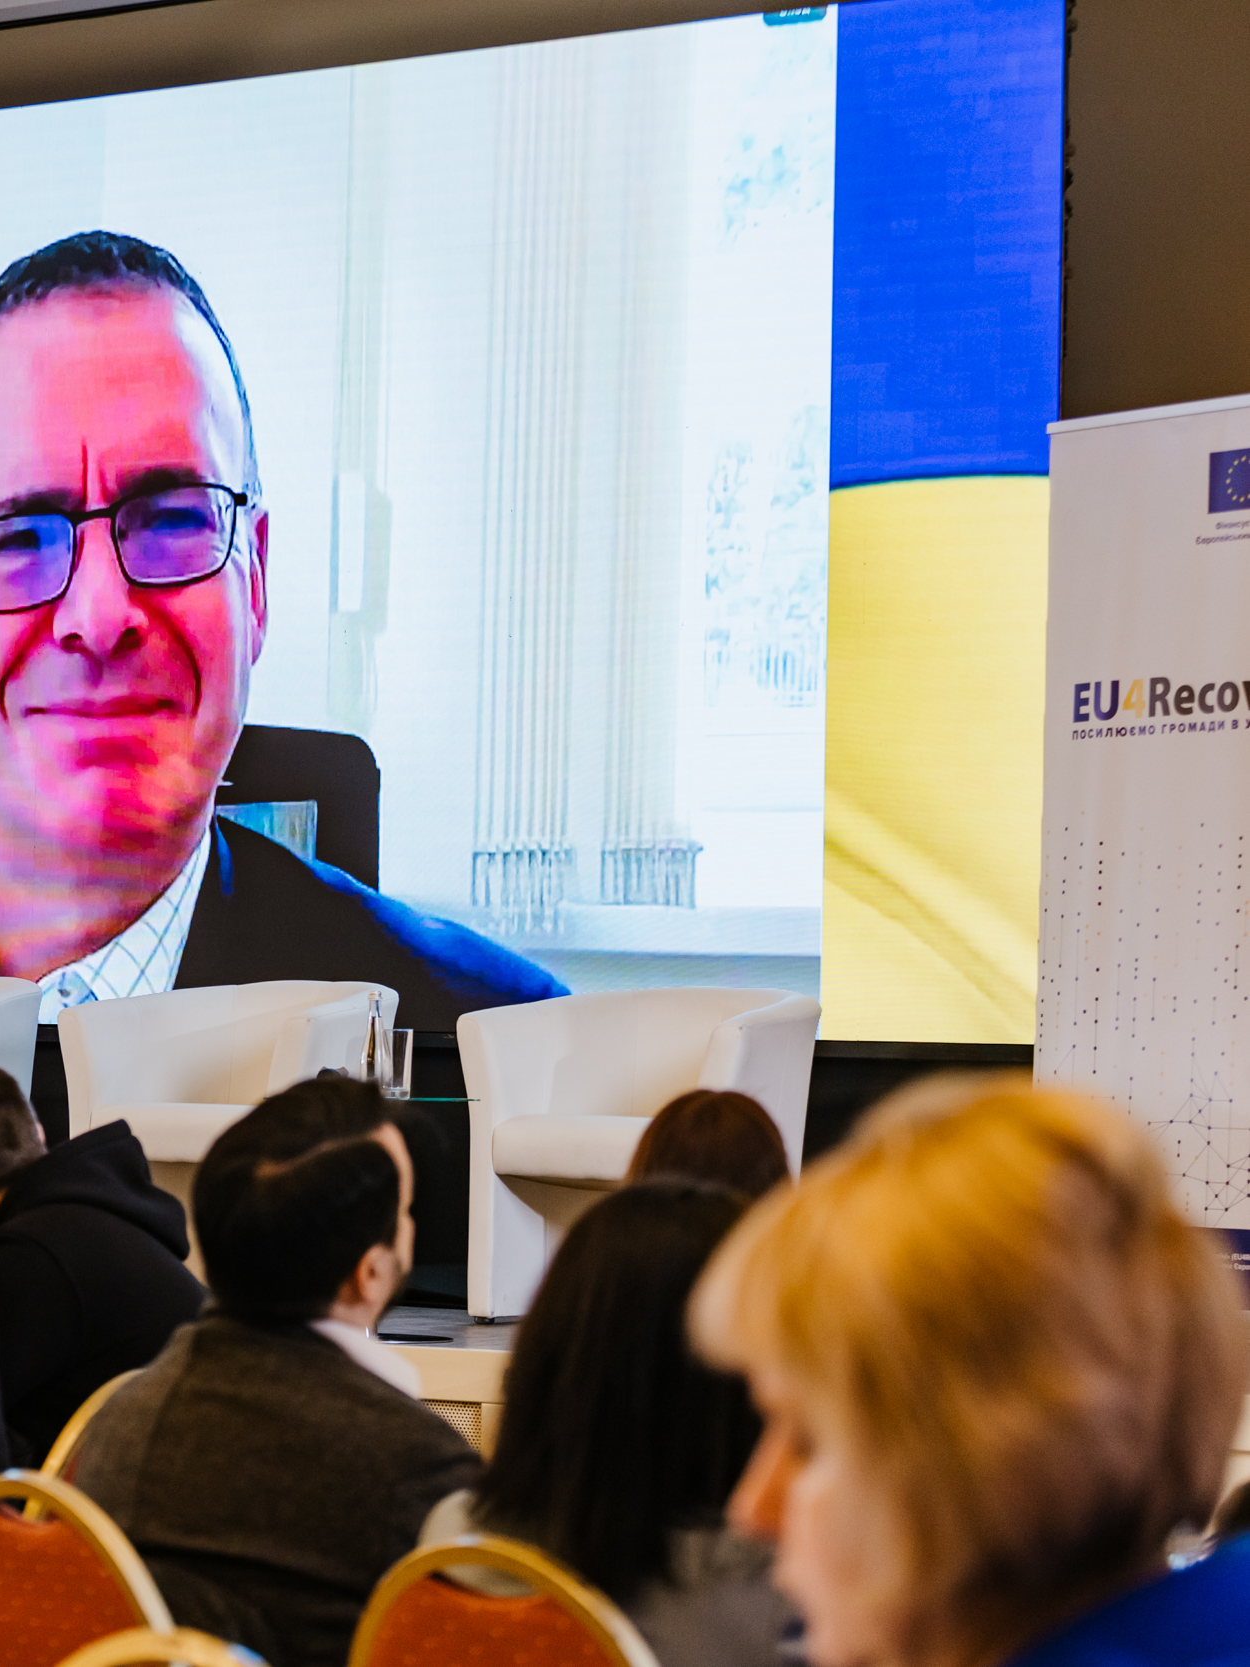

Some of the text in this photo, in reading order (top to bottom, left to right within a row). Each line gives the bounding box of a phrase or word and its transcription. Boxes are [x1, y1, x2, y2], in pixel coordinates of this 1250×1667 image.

[1072, 724, 1156, 741] ПОСИЛЮЄМО
[1161, 720, 1225, 734] ГРОМАДИ
[1231, 719, 1240, 730] В
